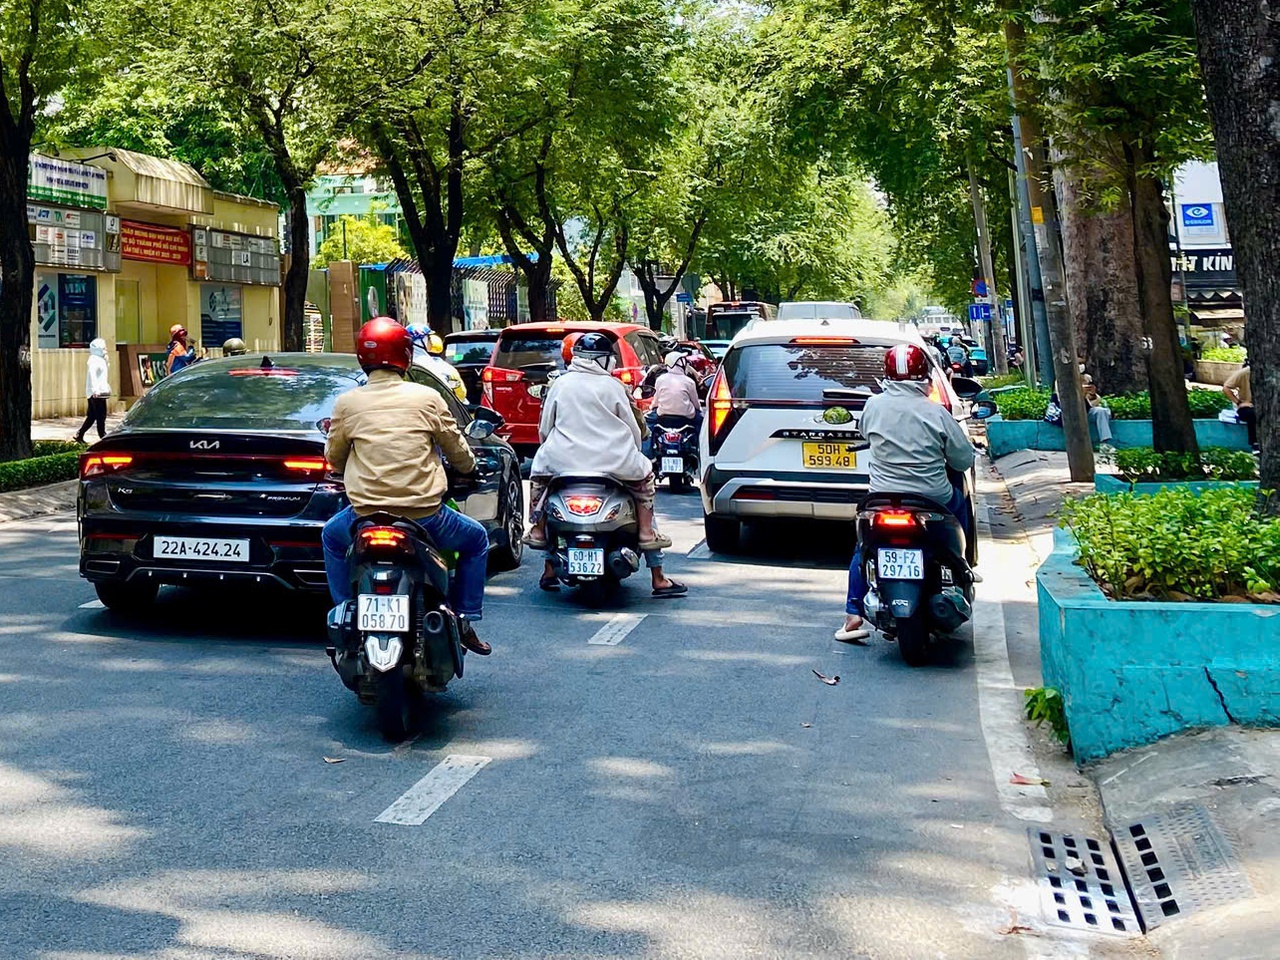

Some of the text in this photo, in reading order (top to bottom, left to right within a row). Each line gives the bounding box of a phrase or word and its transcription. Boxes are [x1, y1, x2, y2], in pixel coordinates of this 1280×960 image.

[1202, 252, 1234, 271] KÍN
[818, 444, 840, 454] 50H
[809, 455, 850, 467] 599.48
[161, 540, 241, 558] 22A-424.24
[573, 551, 598, 562] 60-H1
[884, 551, 916, 564] 59-F2
[570, 562, 602, 574] 536.22
[882, 565, 920, 577] 297.16
[365, 597, 402, 612] 71-K1
[362, 614, 406, 630] 058.70
